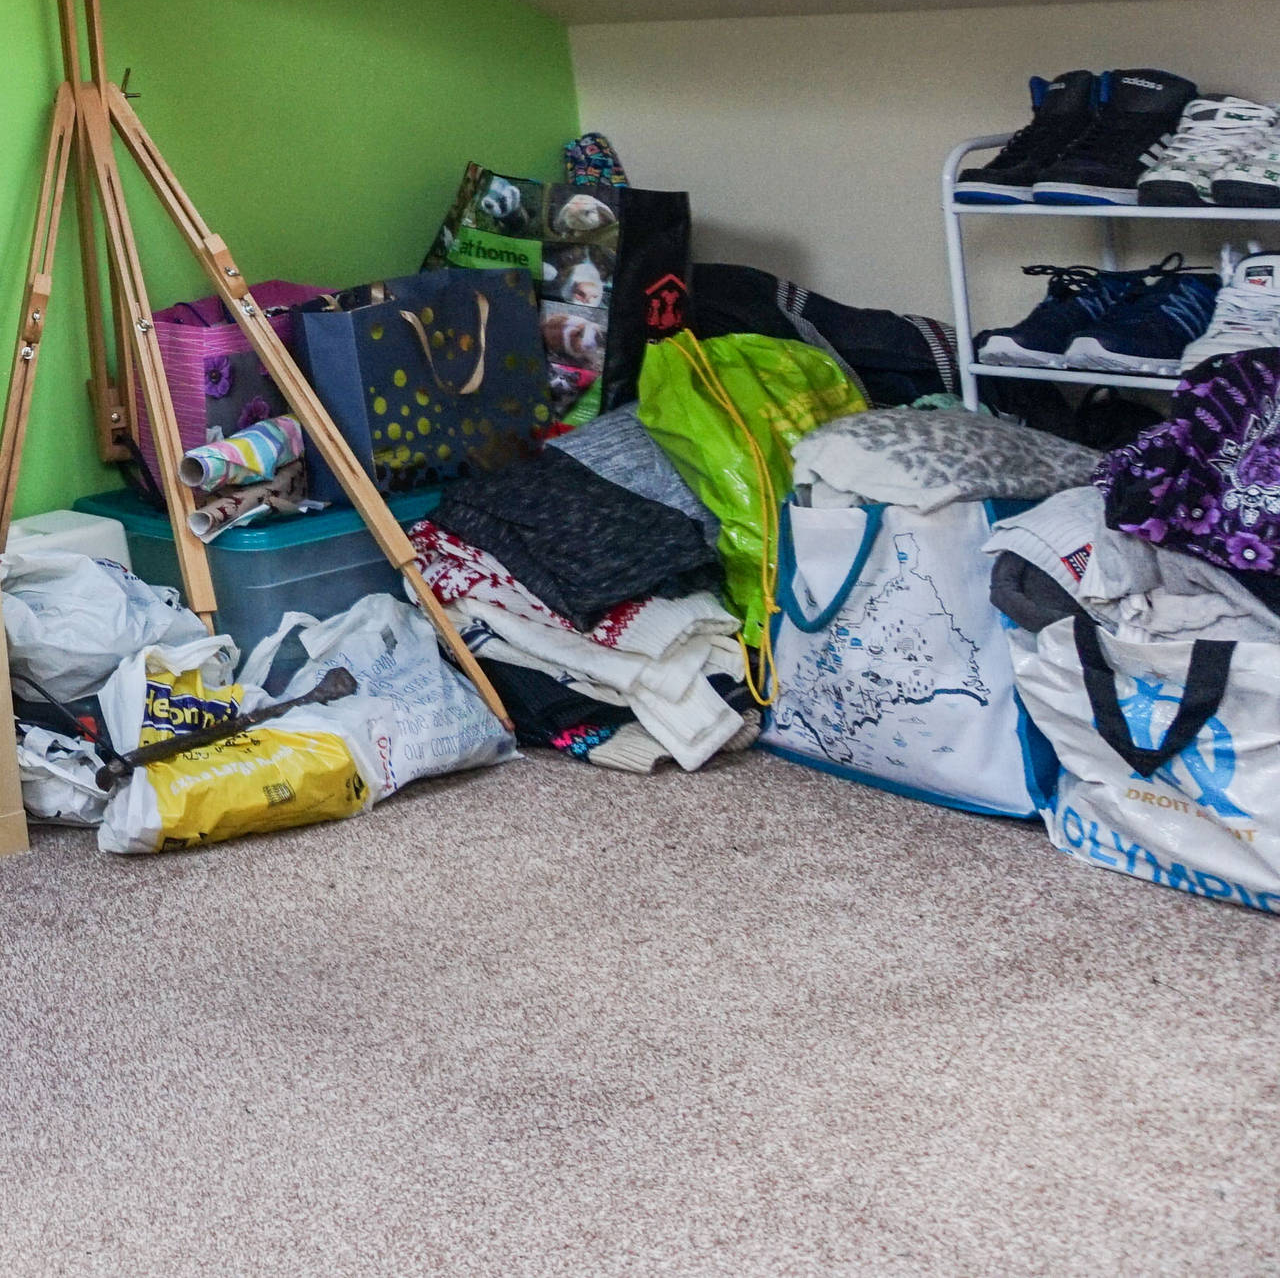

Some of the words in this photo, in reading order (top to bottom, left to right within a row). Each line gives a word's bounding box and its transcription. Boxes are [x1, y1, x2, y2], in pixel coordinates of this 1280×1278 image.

[459, 240, 473, 257] at
[476, 241, 529, 266] home
[1126, 787, 1190, 813] DROIT
